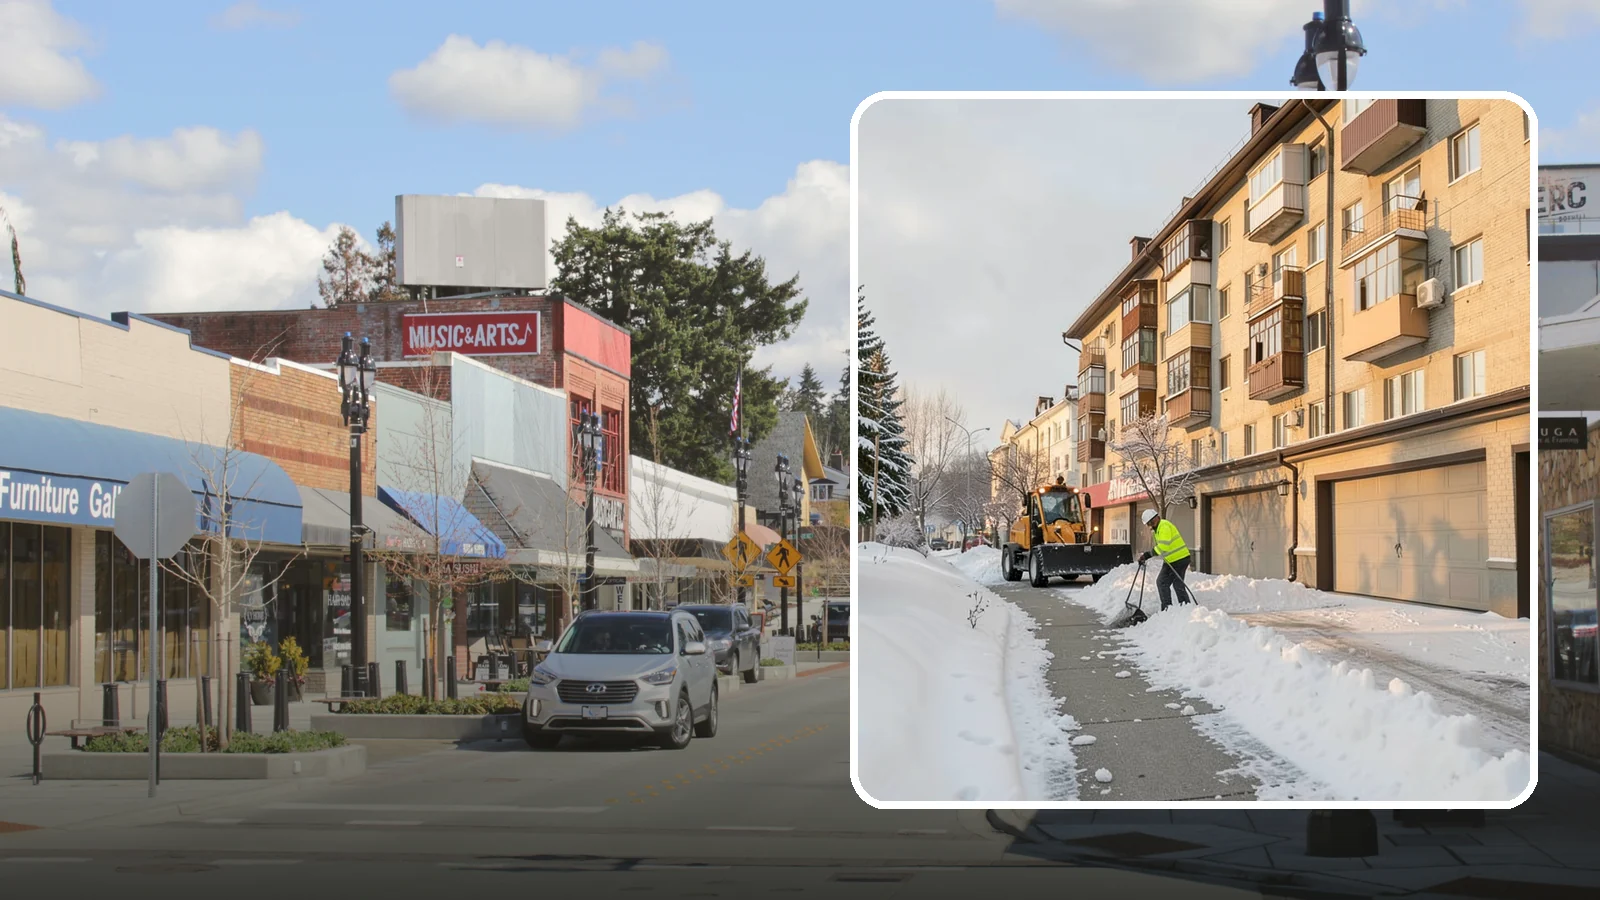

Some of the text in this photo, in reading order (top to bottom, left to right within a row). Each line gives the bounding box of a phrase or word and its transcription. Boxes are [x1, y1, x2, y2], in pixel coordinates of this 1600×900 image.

[409, 323, 519, 349] MUSIC&ARTS
[0, 471, 122, 519] Furniture Gal
[453, 562, 480, 574] SUSHI
